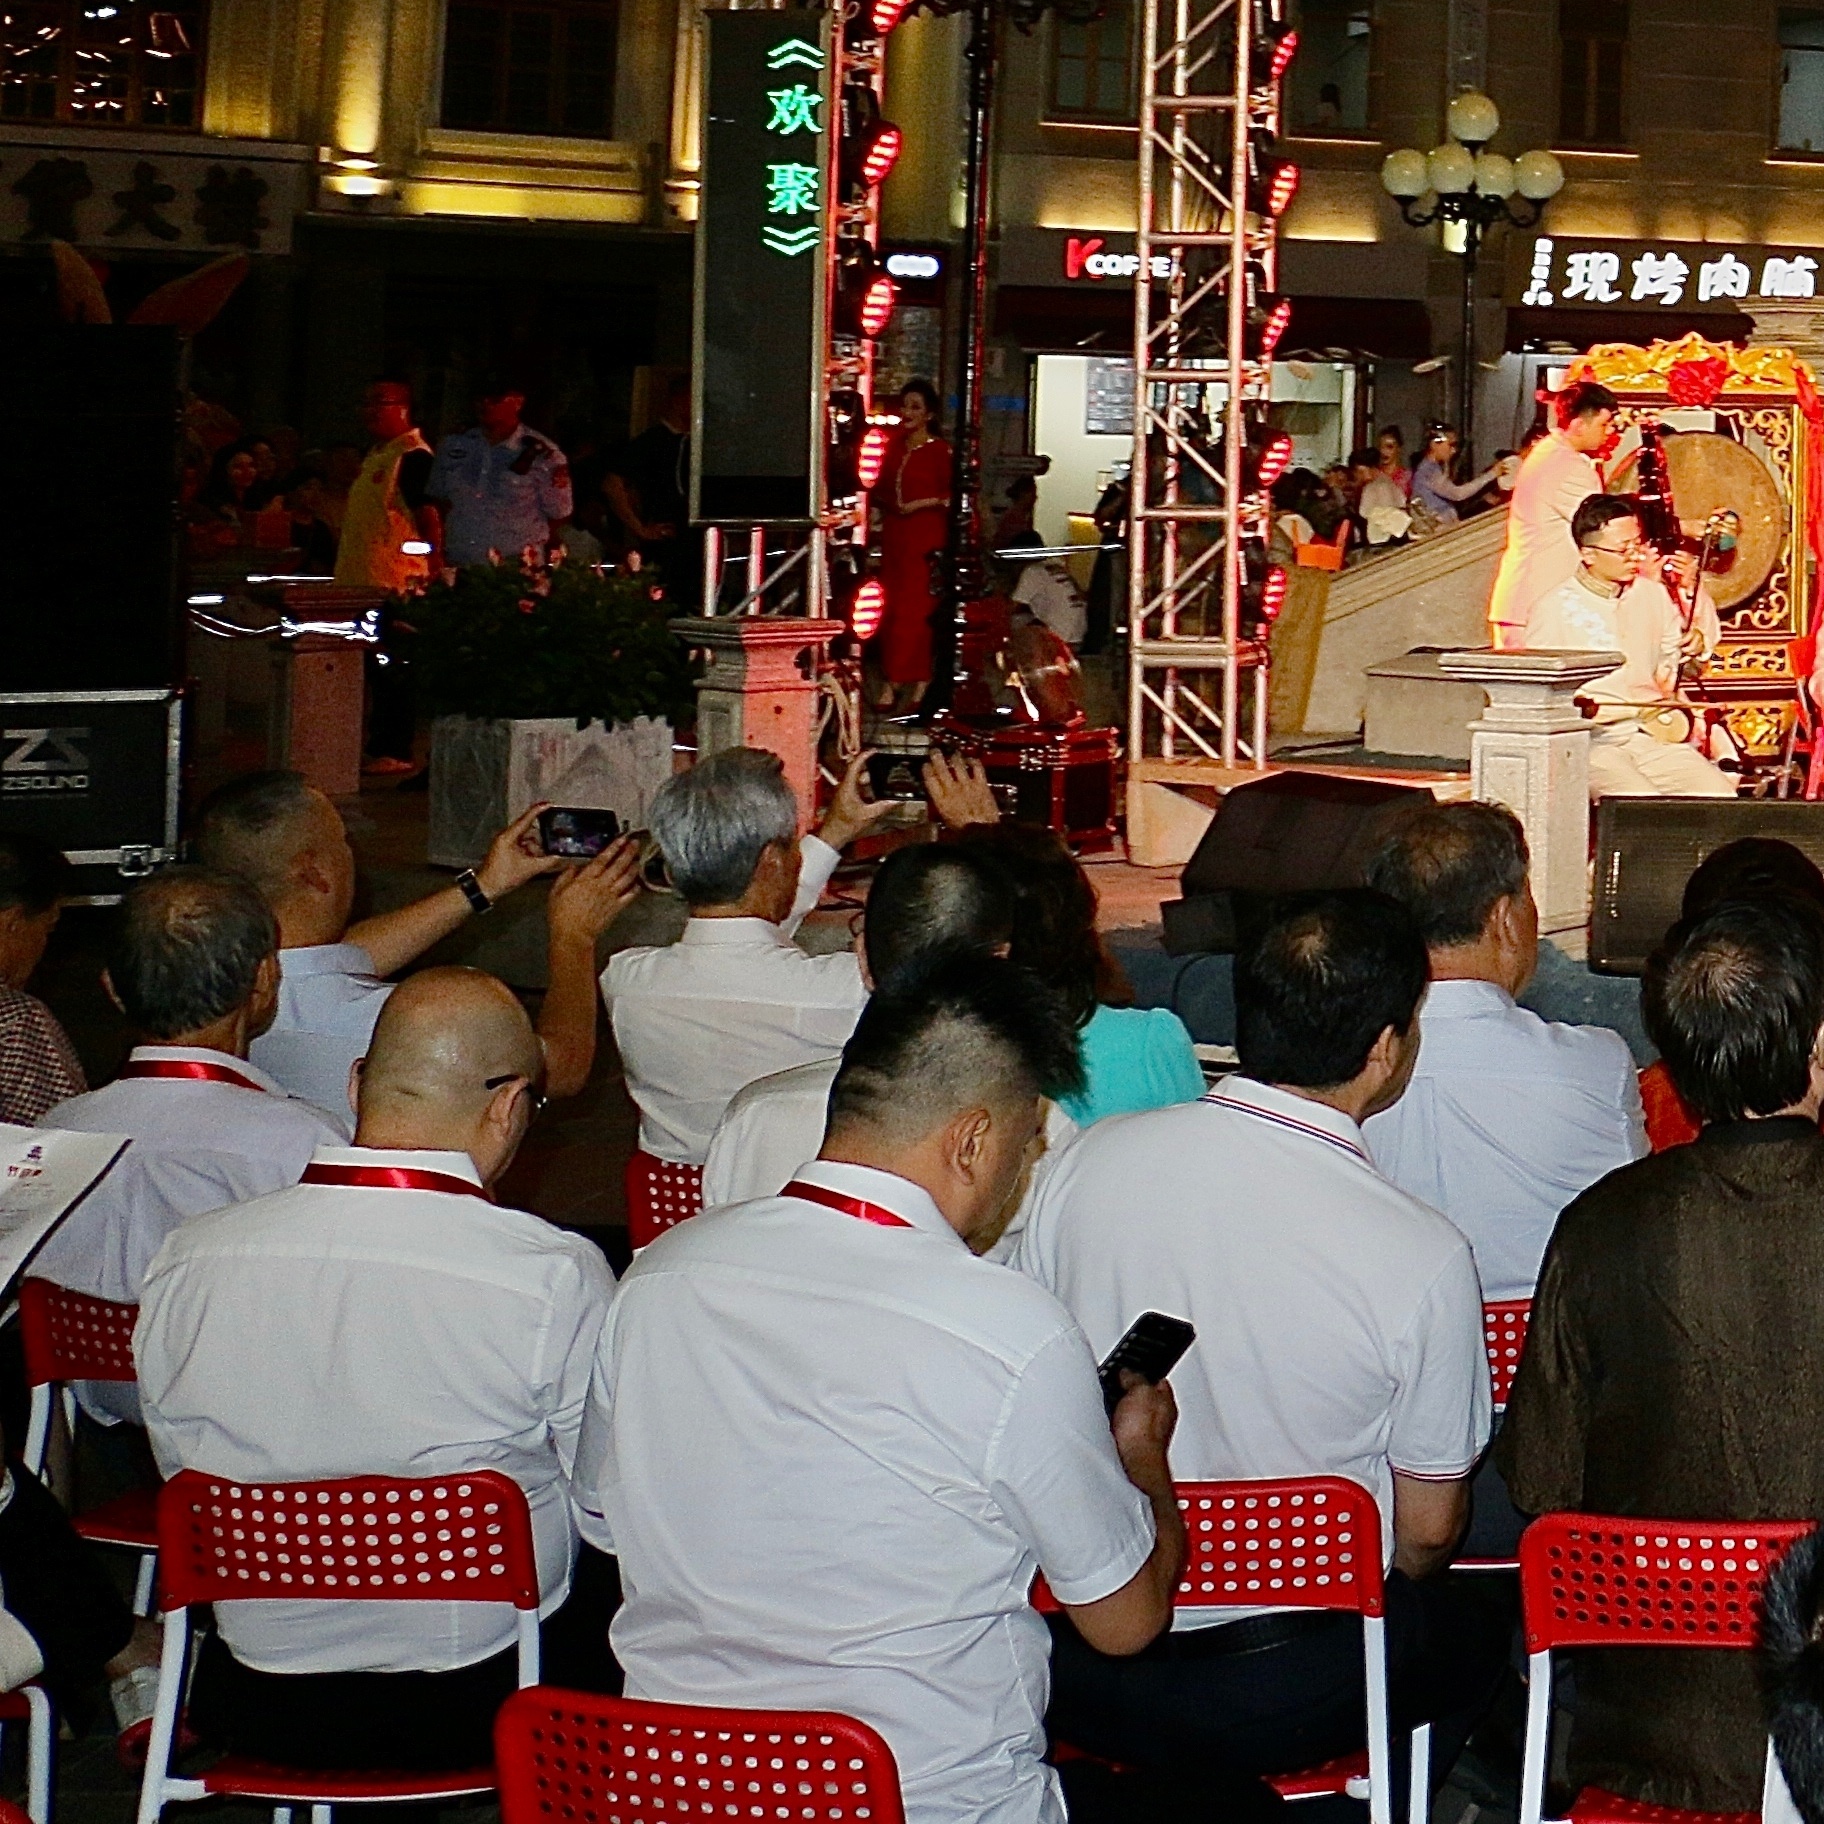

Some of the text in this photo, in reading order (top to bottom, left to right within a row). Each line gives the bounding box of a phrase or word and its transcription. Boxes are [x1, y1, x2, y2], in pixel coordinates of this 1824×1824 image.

[763, 38, 824, 257] 《欢聚》
[1562, 251, 1819, 306] 现烤肉脯
[0, 774, 90, 791] ZSOUND
